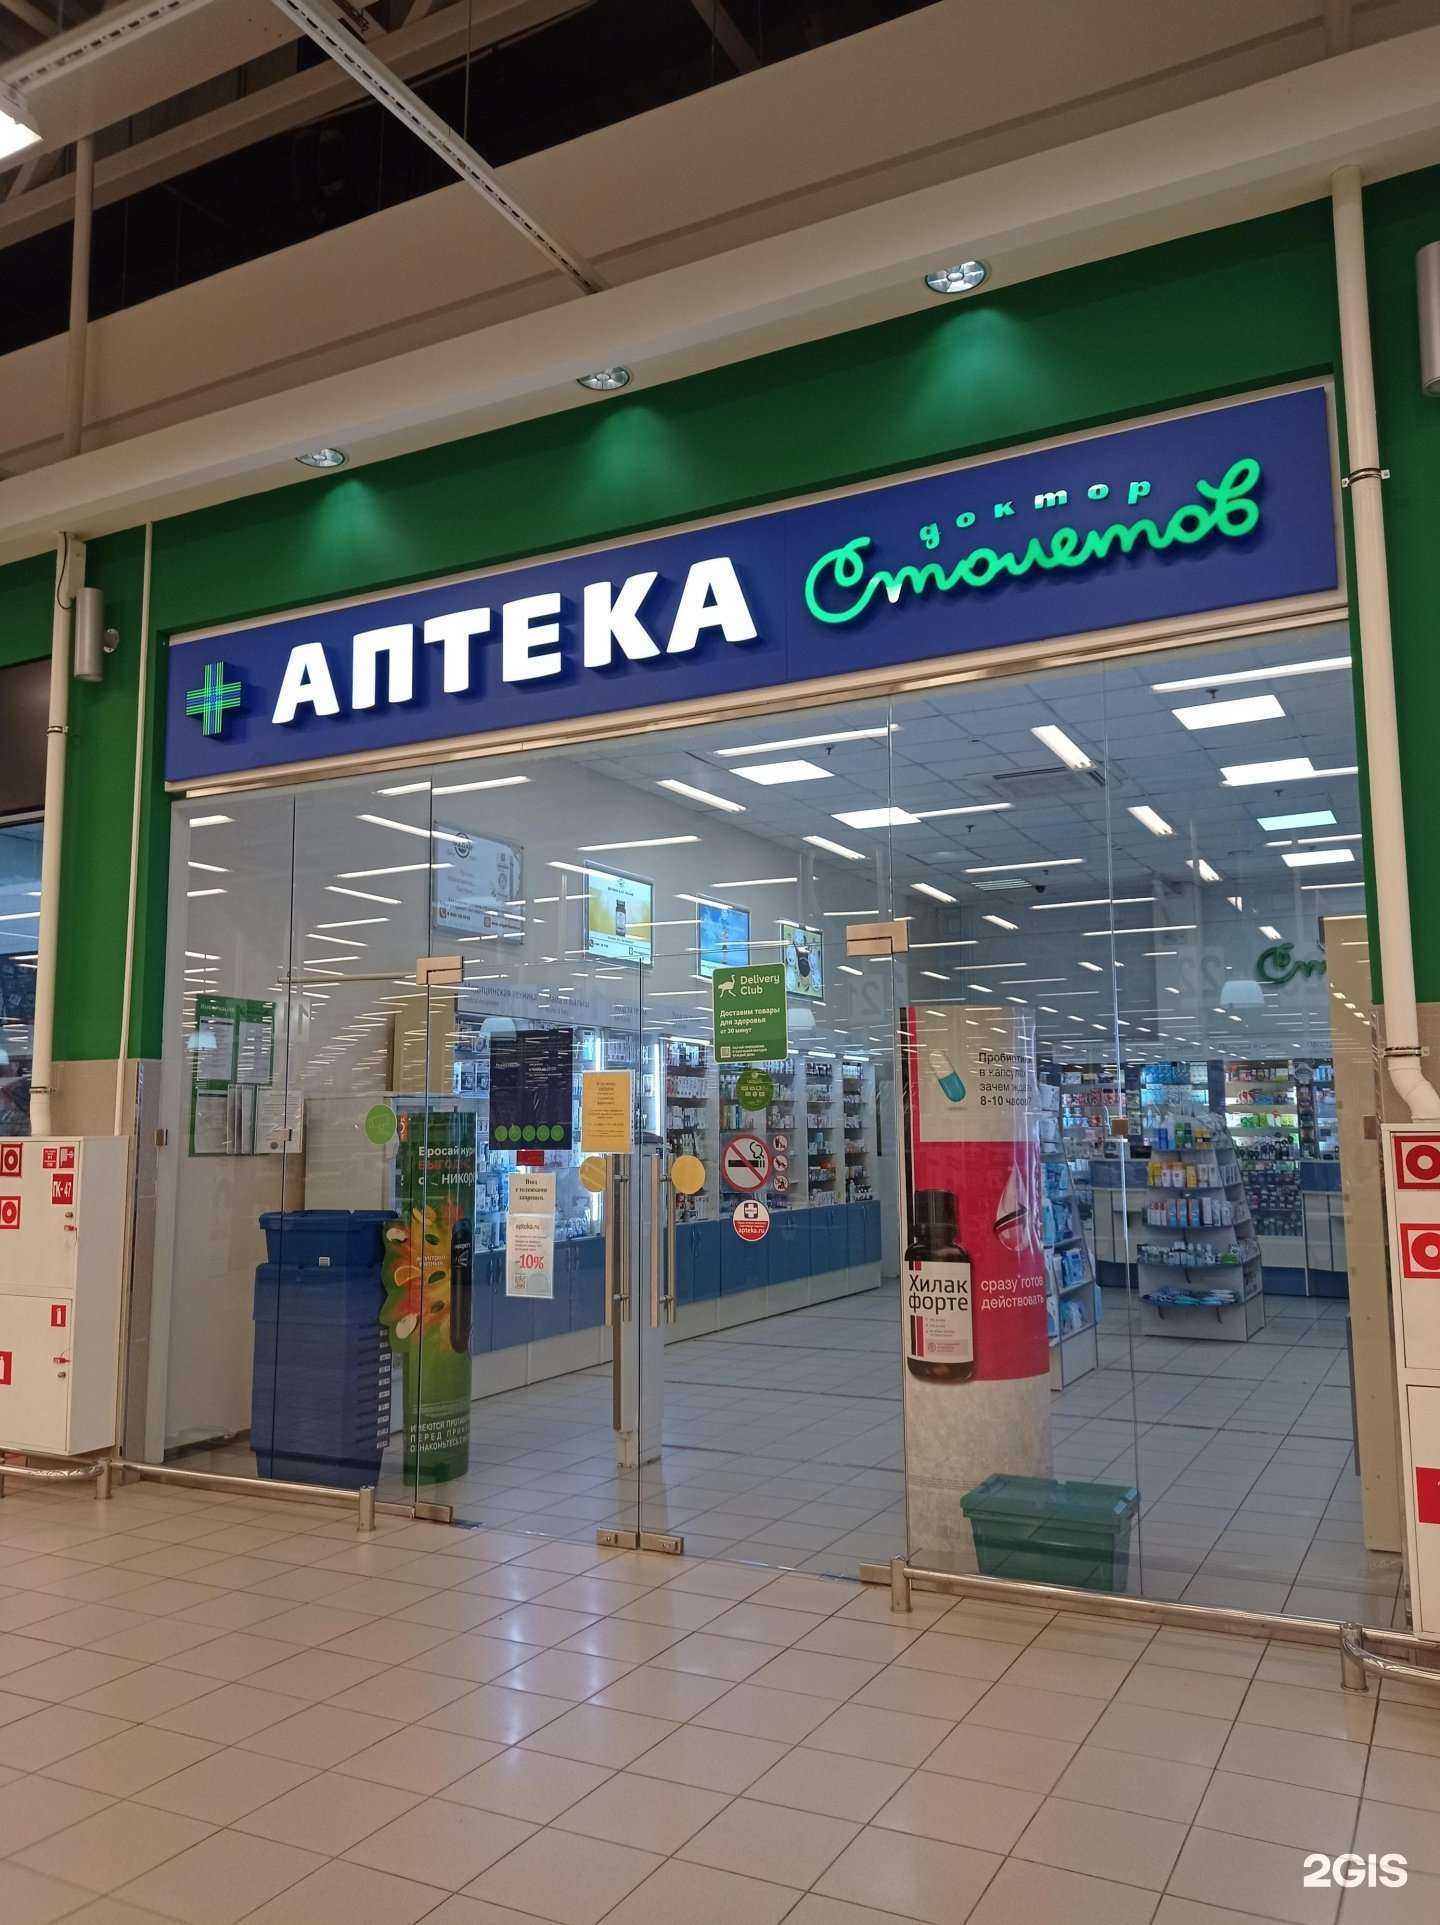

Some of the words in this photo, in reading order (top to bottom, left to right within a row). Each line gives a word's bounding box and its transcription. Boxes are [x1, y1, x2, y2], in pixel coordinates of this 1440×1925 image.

[919, 479, 1152, 549] доктор
[271, 556, 758, 725] АПТЕКА
[804, 458, 1261, 624] Столетов
[740, 974, 780, 984] Delivery
[740, 986, 763, 995] Club
[720, 1010, 753, 1018] Доставим
[755, 1007, 780, 1016] товары
[734, 1018, 766, 1026] здоровья
[980, 1069, 986, 1077] в
[980, 1083, 1010, 1091] зачем
[980, 1095, 1004, 1106] 8-10
[515, 1254, 545, 1270] -10%
[909, 1274, 968, 1294] Хилак
[908, 1293, 968, 1315] форте
[981, 1294, 1044, 1311] действовать
